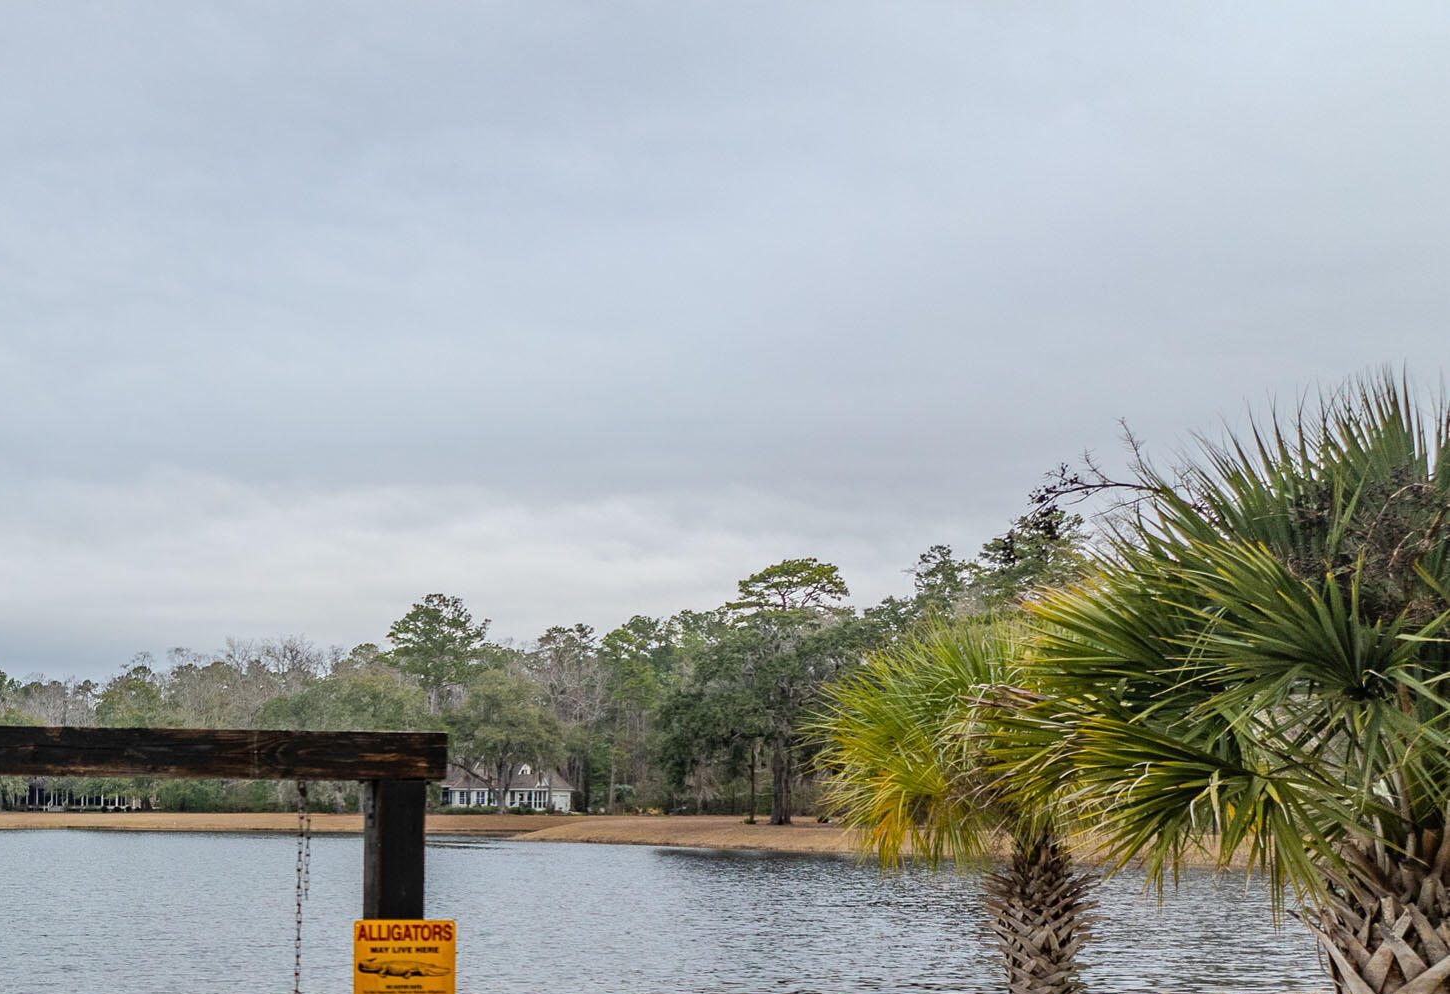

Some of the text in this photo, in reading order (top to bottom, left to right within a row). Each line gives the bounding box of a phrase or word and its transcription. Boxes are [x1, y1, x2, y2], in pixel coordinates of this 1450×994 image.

[357, 924, 453, 941] ALLIGATORS
[370, 946, 439, 954] MAY LIVE HERE
